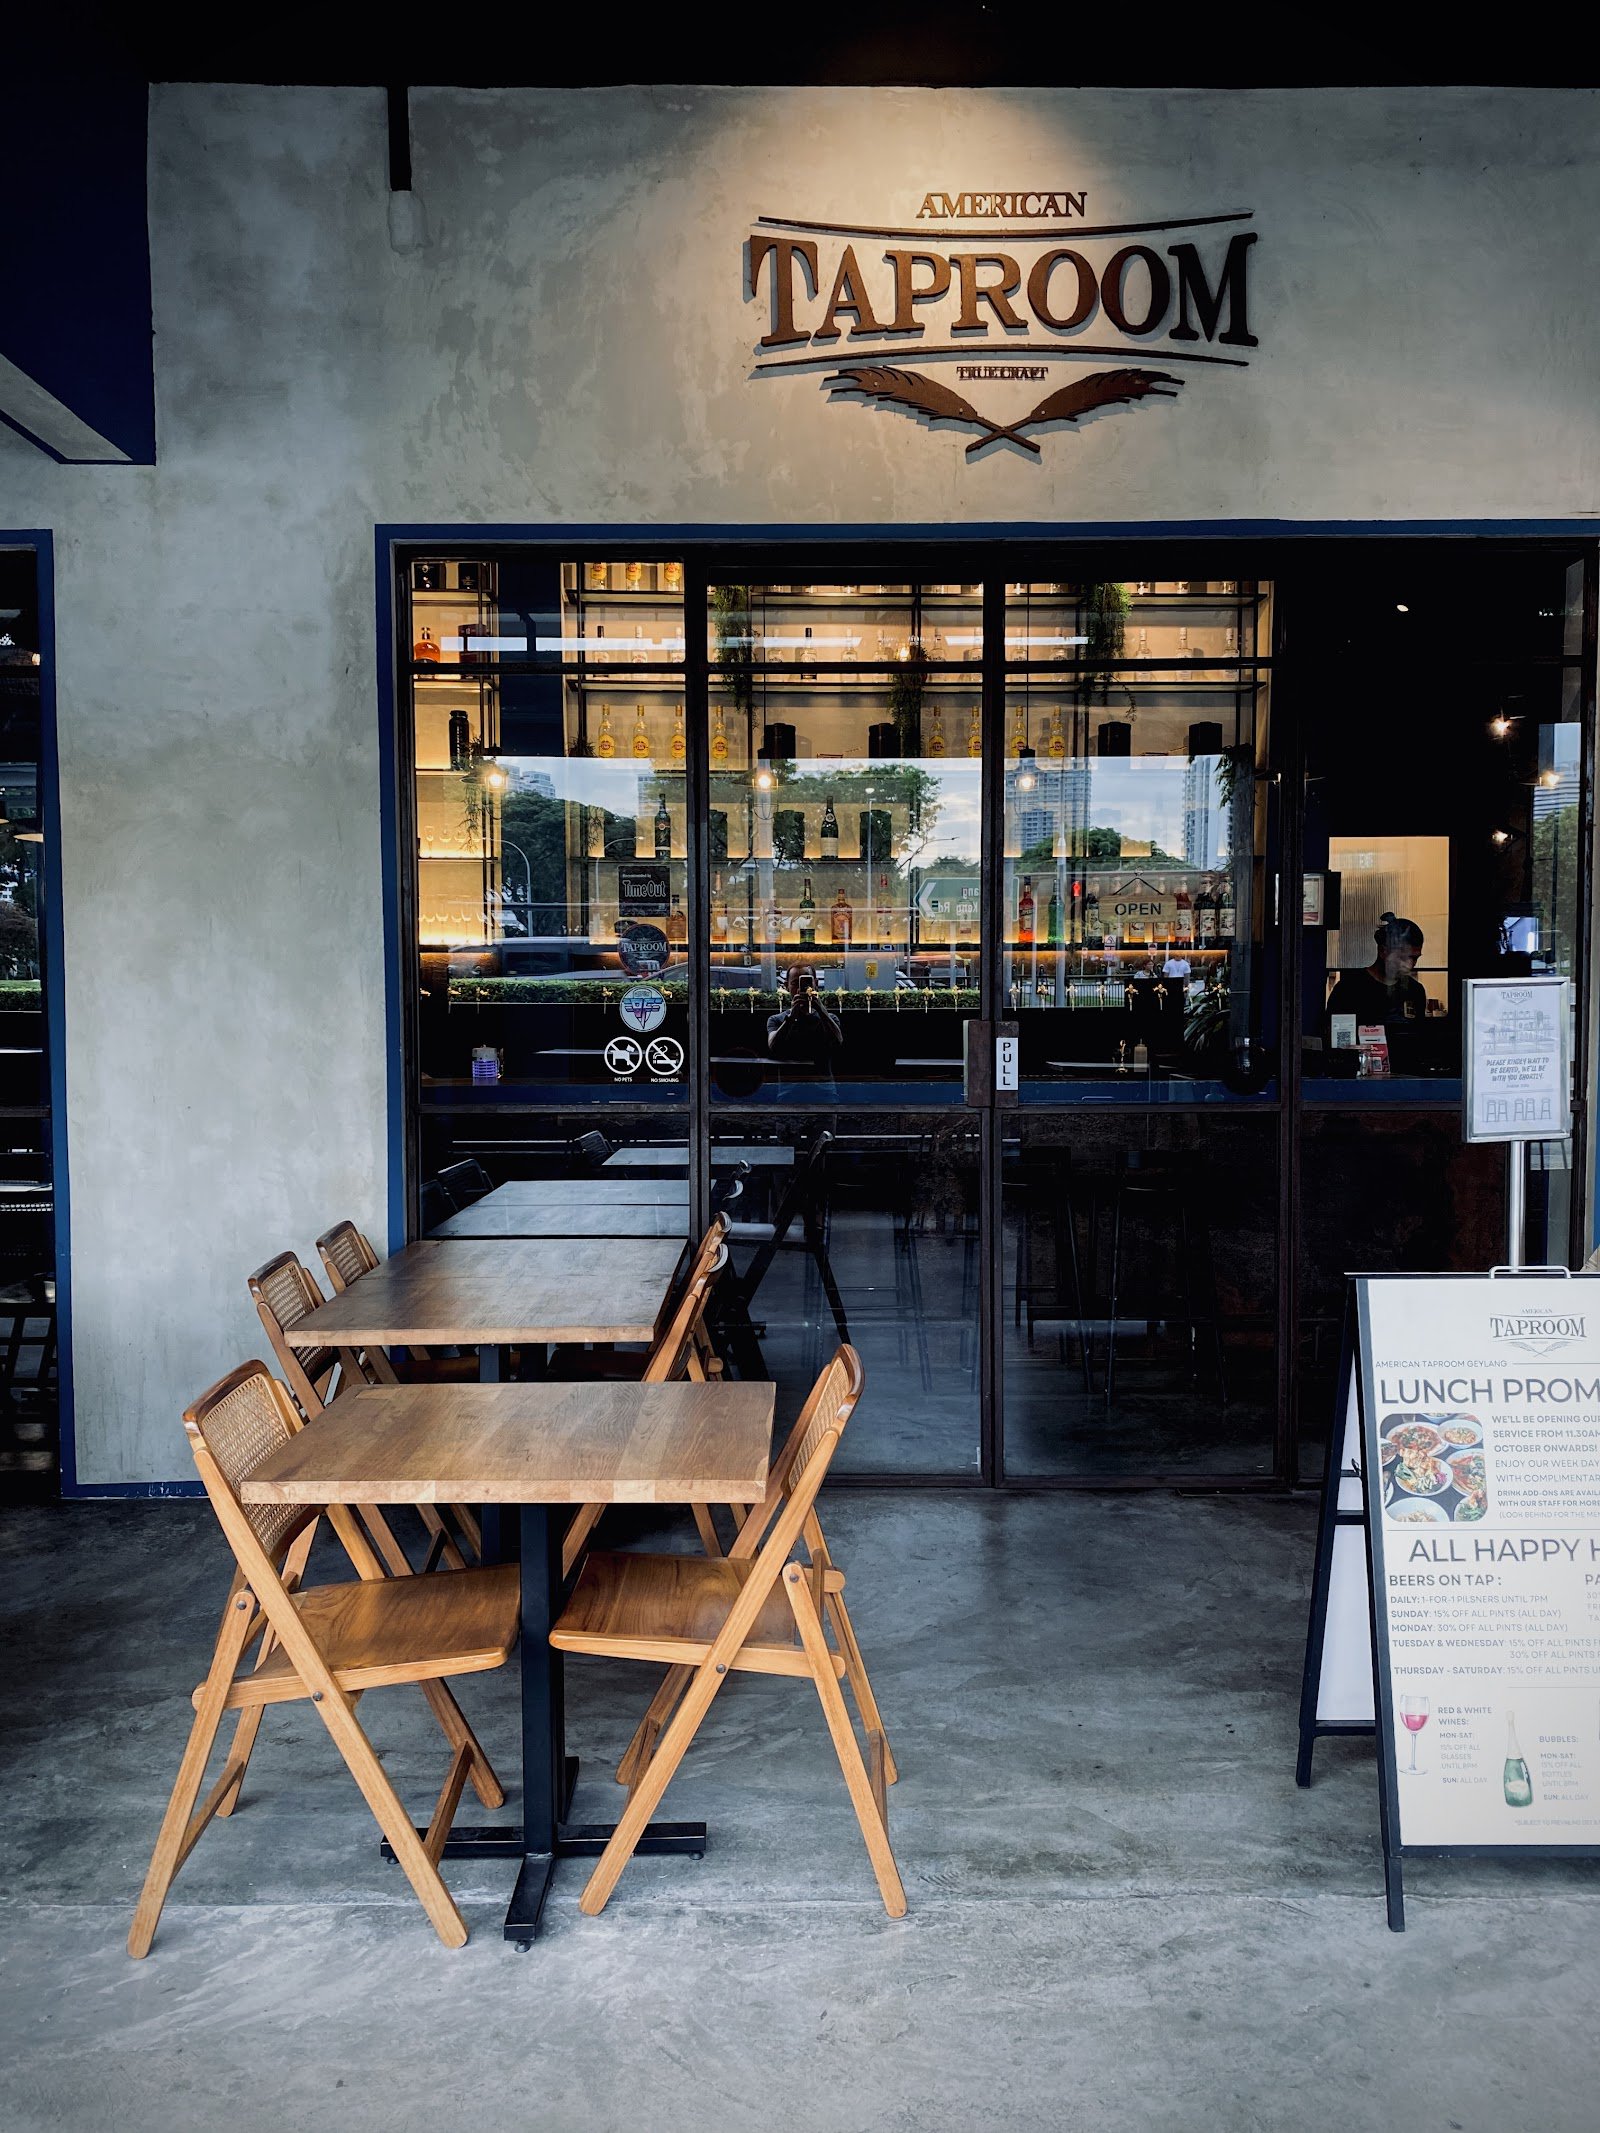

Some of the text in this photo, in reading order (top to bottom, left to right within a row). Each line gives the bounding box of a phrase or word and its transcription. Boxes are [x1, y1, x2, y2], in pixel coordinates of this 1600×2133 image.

[916, 192, 1087, 218] AMERICAN
[749, 232, 1259, 347] TAPROOM
[622, 879, 667, 898] Time Out
[1114, 902, 1162, 917] OPEN
[622, 942, 668, 953] TAPROOM
[1501, 991, 1533, 999] TAPROOM
[1002, 1041, 1012, 1087] PULL
[1492, 1074, 1507, 1082] WITH
[1507, 1074, 1518, 1082] YOU
[1489, 1316, 1588, 1338] TAPROOM
[1375, 1360, 1508, 1368] AMERICAN TAPROOM GEYLANG
[1380, 1378, 1494, 1404] LUNCH
[1491, 1415, 1521, 1424] WE'LL
[1522, 1415, 1535, 1423] BE
[1536, 1415, 1581, 1424] OPENING
[1493, 1430, 1534, 1438] SERVICE
[1535, 1430, 1564, 1438] FROM
[1494, 1444, 1598, 1453] OCTOBER ONWARDS!
[1495, 1459, 1600, 1468] ENJOY OUR WEEK DAY
[1496, 1474, 1522, 1483] WITH
[1499, 1511, 1523, 1519] (LOOK
[1524, 1511, 1552, 1519] BEHIND
[1408, 1538, 1467, 1562] ALL
[1473, 1538, 1580, 1562] HAPPY
[1389, 1574, 1436, 1586] BEERS
[1438, 1574, 1461, 1586] ON
[1390, 1595, 1421, 1604] DAILY:
[1457, 1595, 1500, 1604] PILSNERS
[1501, 1595, 1528, 1603] UNTIL
[1530, 1595, 1548, 1603] 7PM
[1391, 1609, 1562, 1618] SUNDAY: 15% OFF ALL PINTS (ALL DAY)
[1391, 1623, 1568, 1632] MONDAY: 30% OFF ALL PINTS (ALL DAY)
[1393, 1639, 1436, 1647] TUESDAY
[1437, 1639, 1443, 1647] &
[1509, 1639, 1526, 1647] 15%
[1527, 1639, 1544, 1647] OFF
[1547, 1639, 1563, 1647] ALL
[1566, 1639, 1592, 1647] PINTS
[1510, 1651, 1529, 1659] 30%
[1531, 1651, 1548, 1659] OFF
[1551, 1651, 1567, 1659] ALL
[1569, 1650, 1595, 1658] PINTS
[1394, 1666, 1444, 1675] THURSDAY
[1507, 1666, 1524, 1674] 15%
[1525, 1666, 1543, 1674] OFF
[1545, 1666, 1561, 1674] ALL
[1564, 1666, 1590, 1674] PINTS
[1438, 1706, 1492, 1714] RED & WHITE
[1438, 1718, 1470, 1726] WINES:
[1539, 1735, 1579, 1743] BUBBLES:
